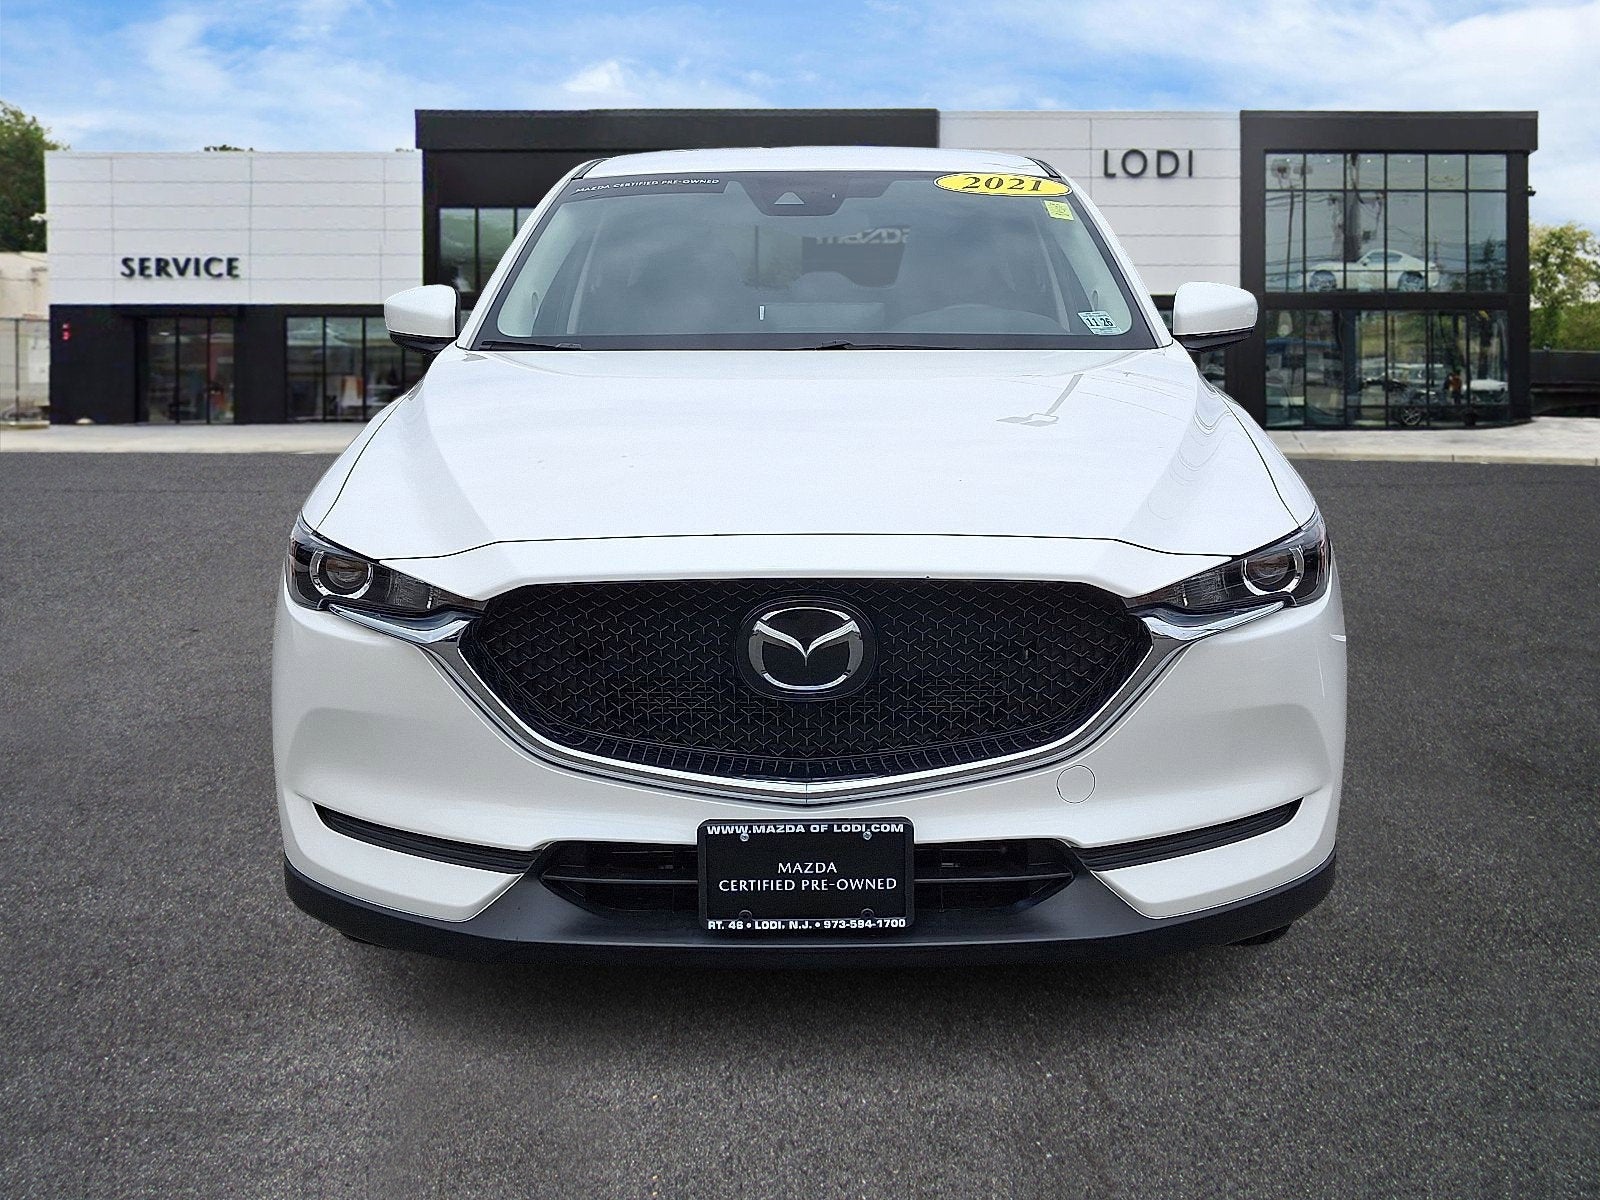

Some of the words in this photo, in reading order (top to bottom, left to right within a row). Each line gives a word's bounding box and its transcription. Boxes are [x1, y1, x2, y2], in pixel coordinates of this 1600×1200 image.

[1103, 148, 1193, 179] LODI
[575, 184, 610, 193] MAZDA
[613, 180, 659, 189] CERTIFIED
[961, 176, 1042, 192] 2021
[120, 257, 240, 278] SERVICE
[706, 824, 806, 835] WWW.MAZDA
[810, 824, 829, 833] OF
[833, 823, 904, 833] LODI.COM
[777, 862, 838, 874] MAZDA
[718, 879, 796, 892] CERTIFIED
[801, 878, 897, 891] PRE-OWNED
[707, 920, 725, 930] RT.
[788, 920, 813, 930] N.J.
[823, 919, 906, 929] 973-594-1700
